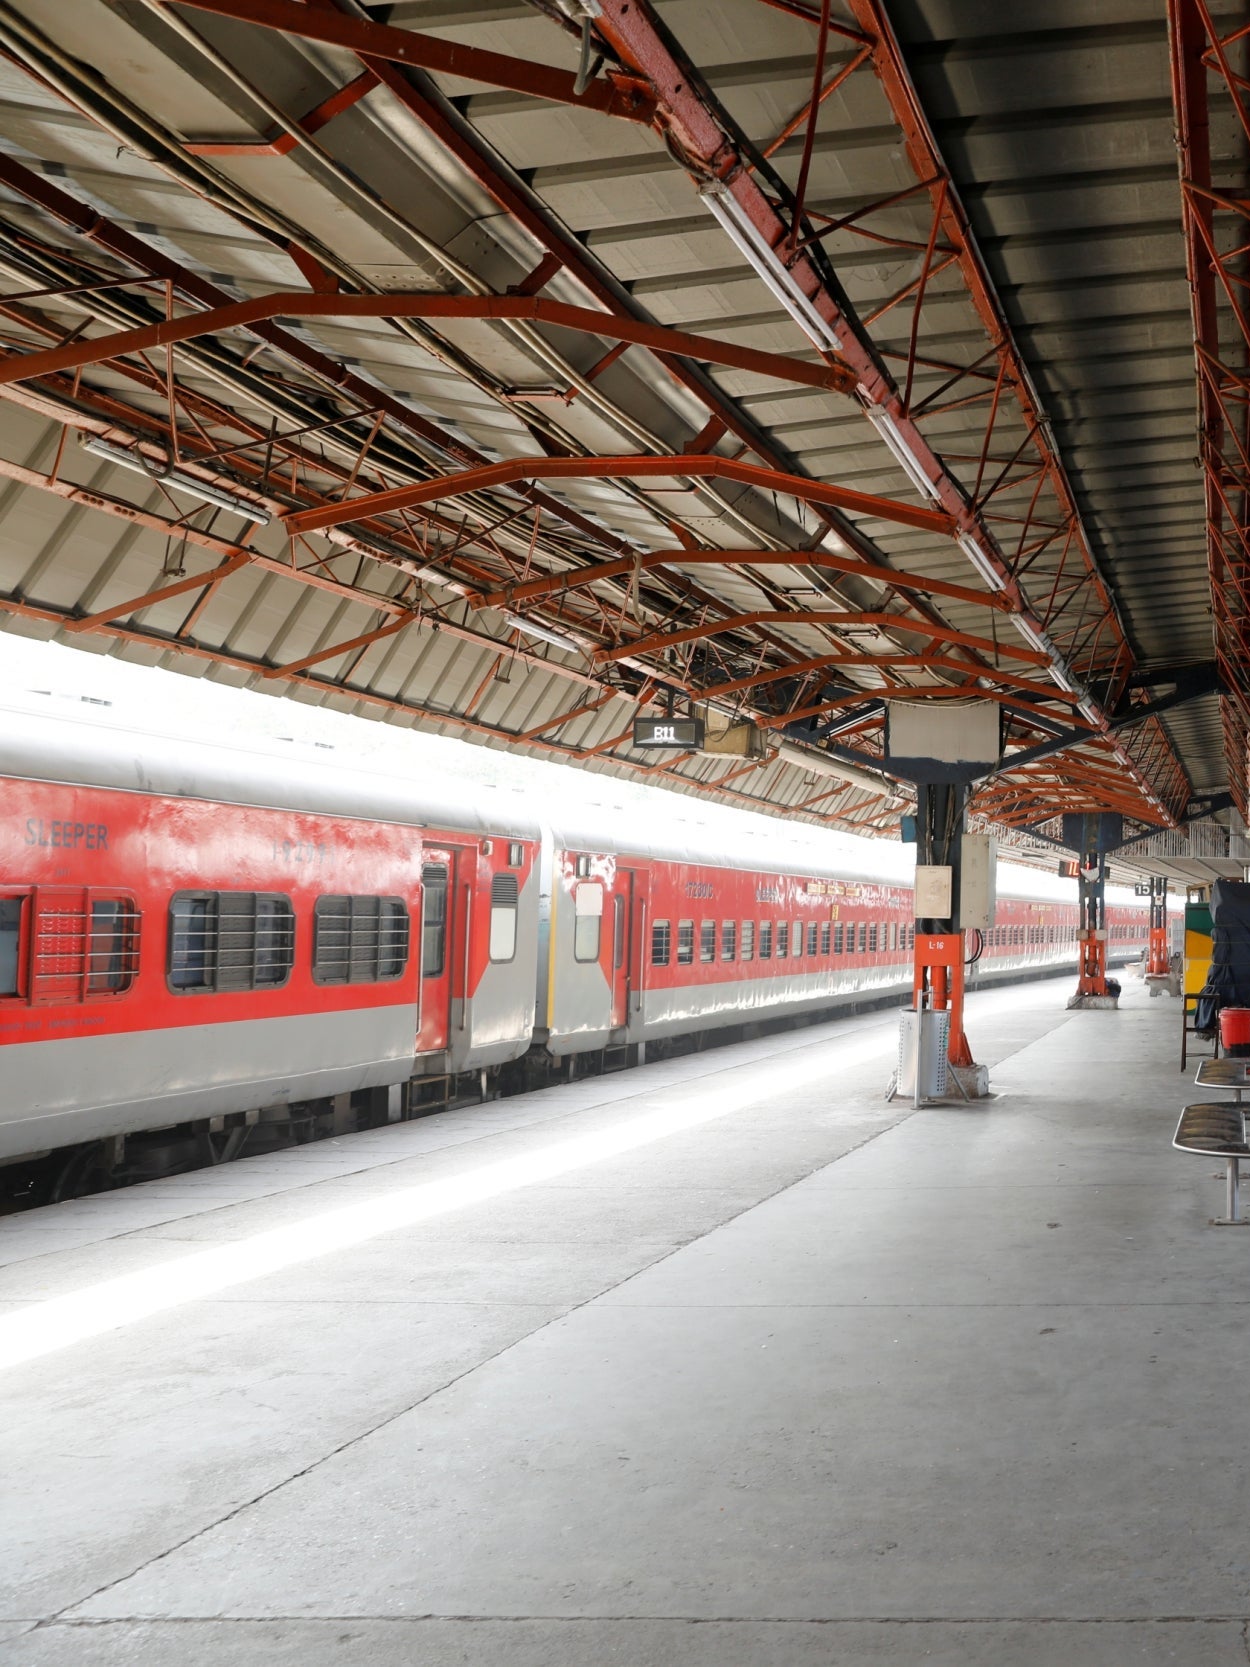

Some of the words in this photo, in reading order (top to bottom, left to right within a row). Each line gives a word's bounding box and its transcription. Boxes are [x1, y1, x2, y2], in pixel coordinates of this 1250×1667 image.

[653, 726, 675, 741] B11
[24, 818, 109, 850] SLEEPER
[1136, 884, 1150, 895] 15
[928, 941, 945, 950] L-16
